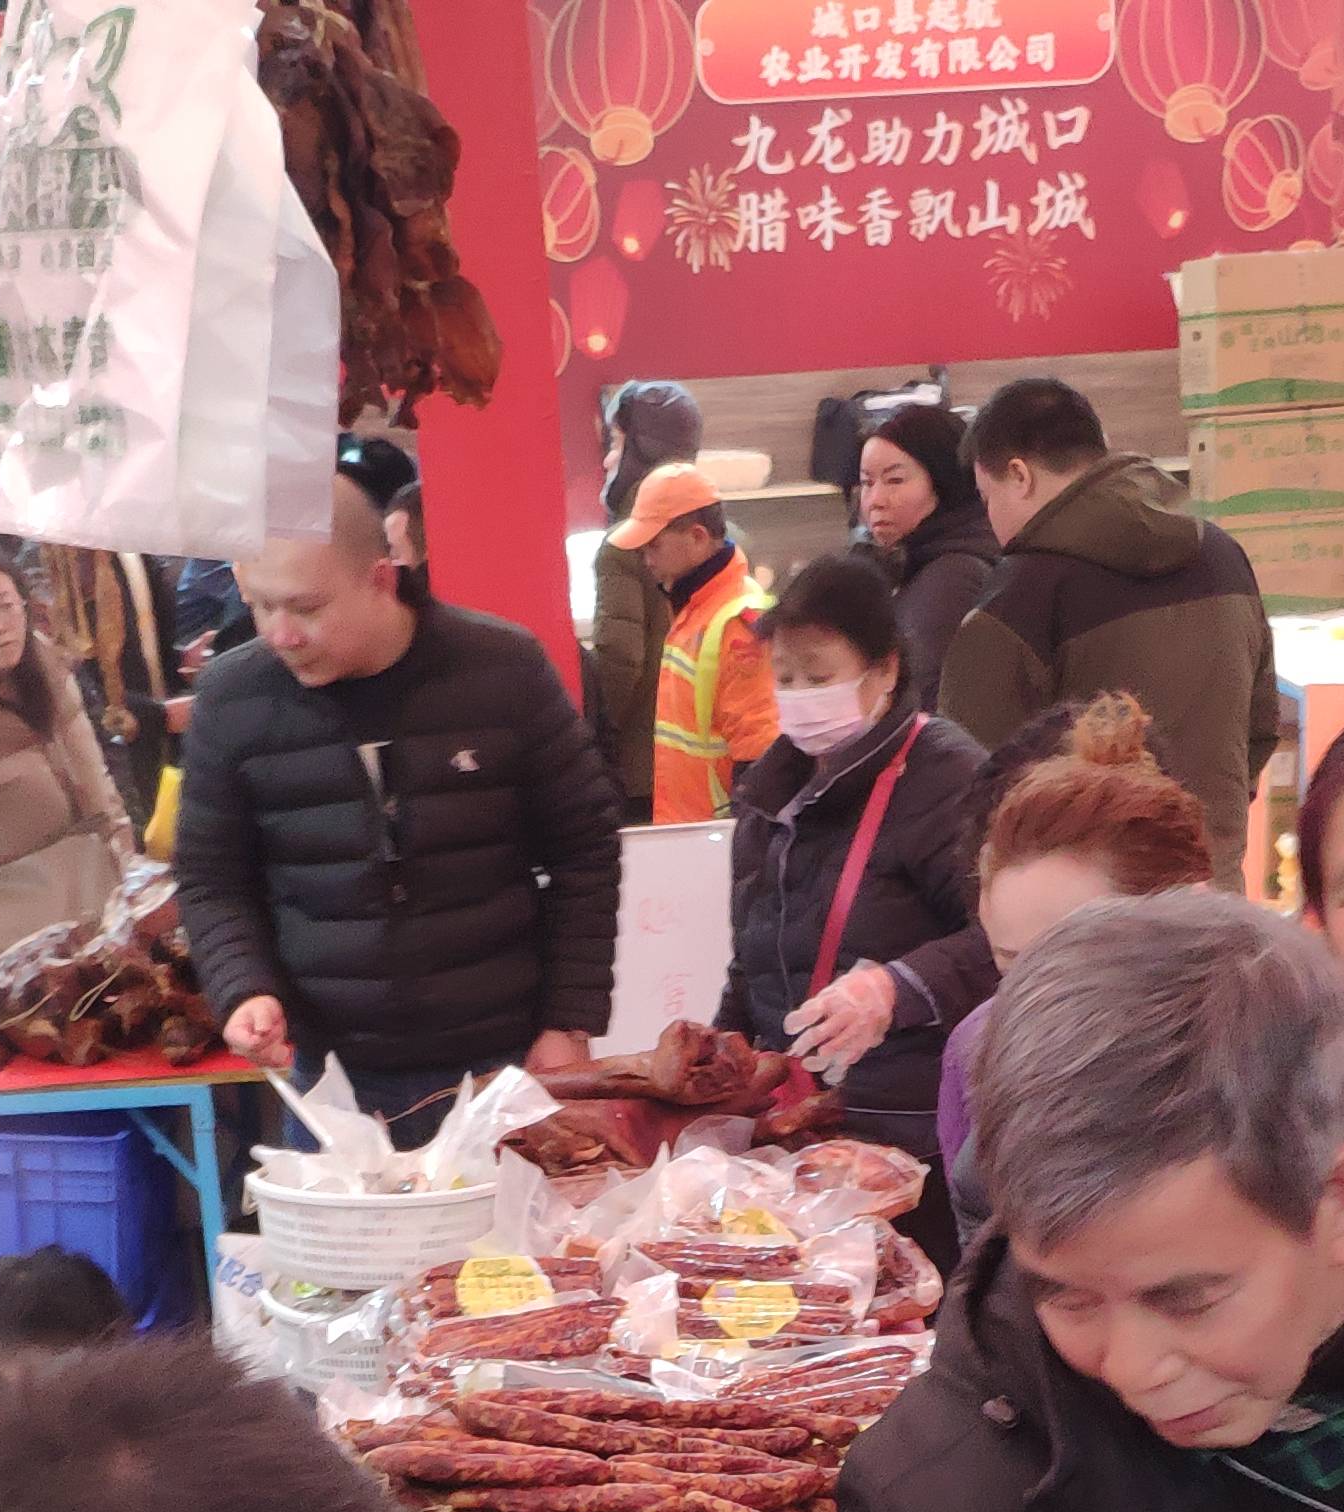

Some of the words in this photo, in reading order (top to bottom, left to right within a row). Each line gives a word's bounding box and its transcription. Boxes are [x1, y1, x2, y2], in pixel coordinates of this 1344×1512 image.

[760, 32, 1056, 87] 农业开发有限公司
[731, 97, 1092, 175] 九龙助力城口
[732, 170, 1097, 254] 腊味香飘山城
